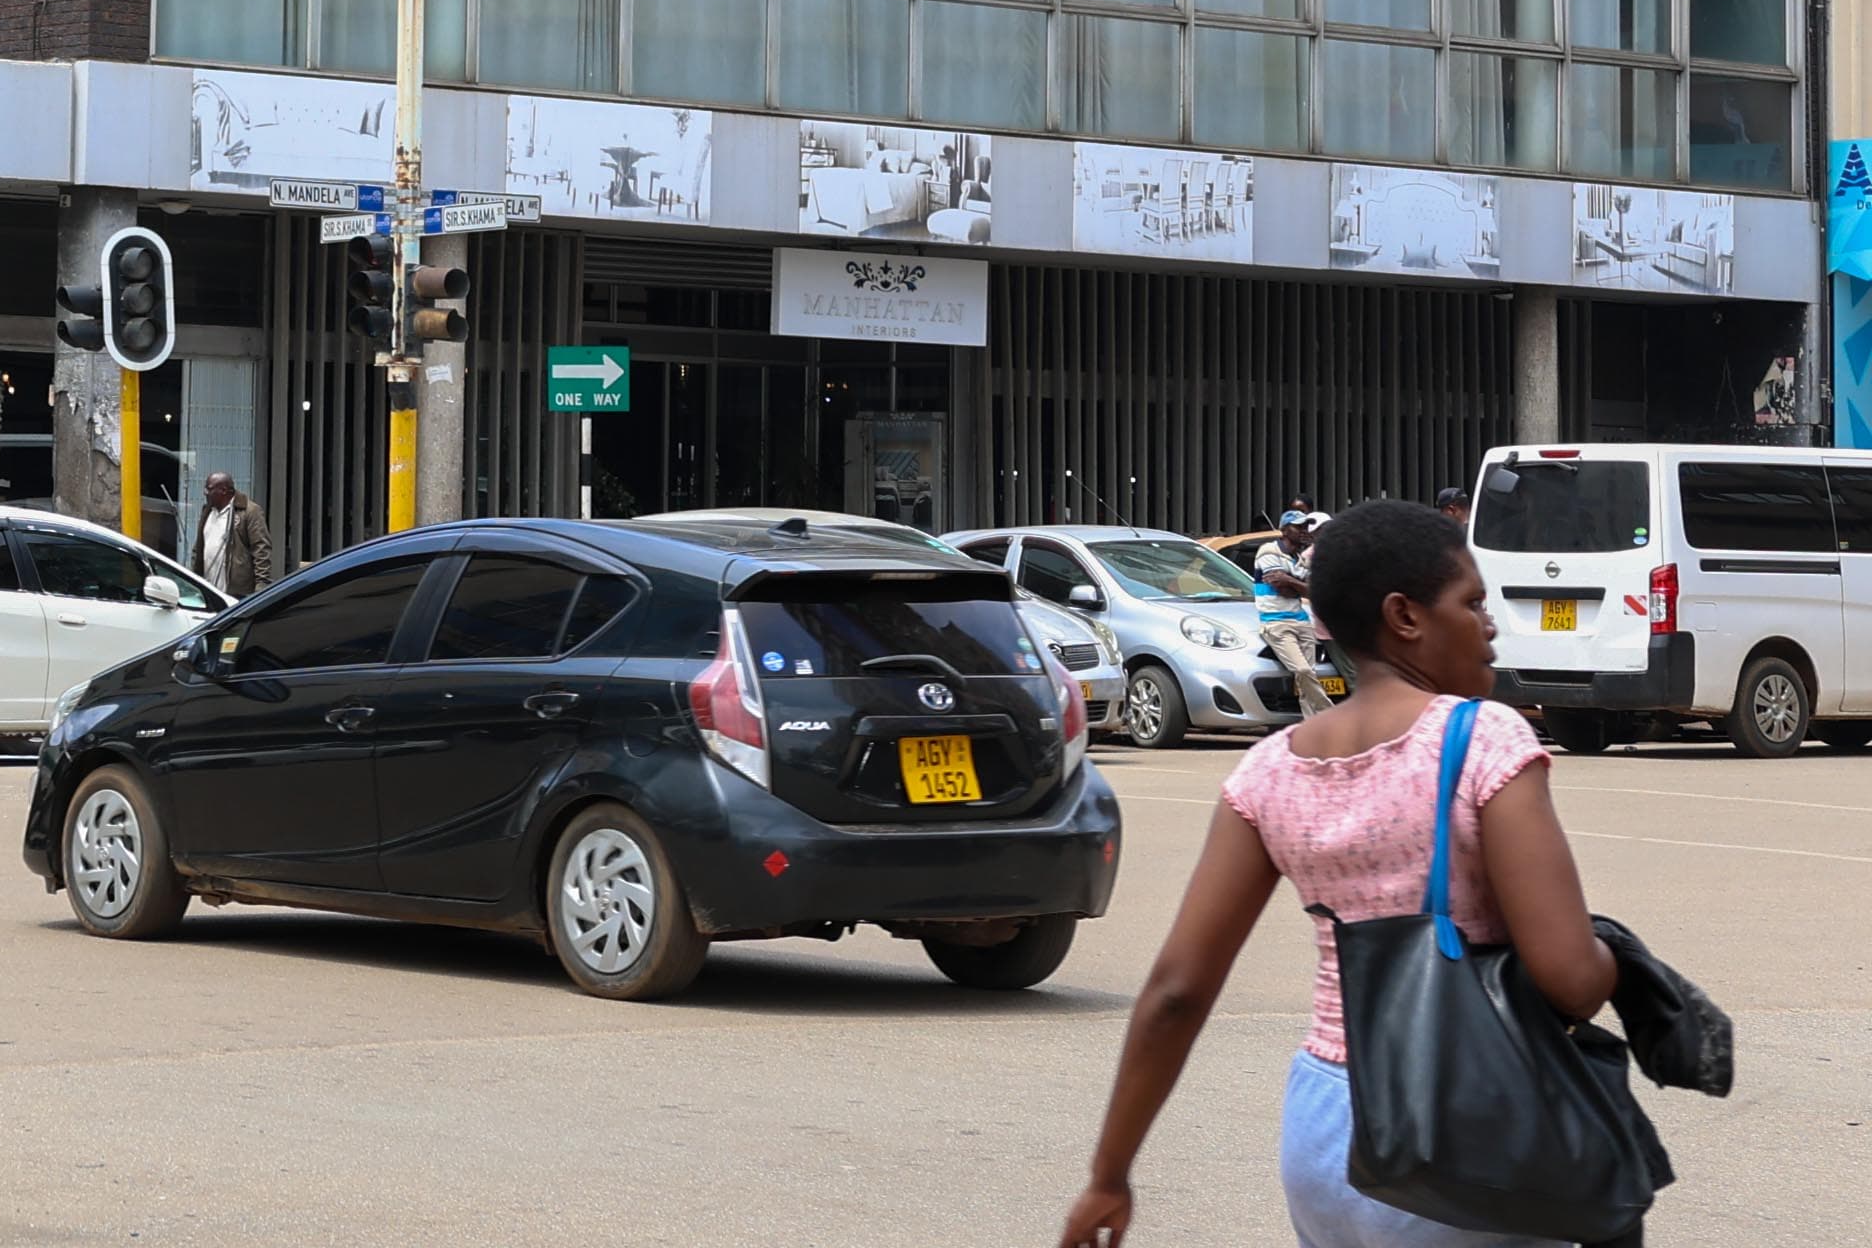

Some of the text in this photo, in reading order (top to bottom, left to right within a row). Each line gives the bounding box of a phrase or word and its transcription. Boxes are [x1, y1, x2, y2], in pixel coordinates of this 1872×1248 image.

[273, 183, 355, 205] N. MANDELA AVE
[801, 293, 965, 325] MANHATTAN
[851, 324, 918, 338] INTERIORS
[555, 392, 621, 406] ONE WAY
[1548, 601, 1567, 614] AGY
[1547, 616, 1571, 630] 7641
[778, 721, 832, 731] AQUA
[916, 739, 951, 767] AGY
[920, 771, 972, 799] 1452
